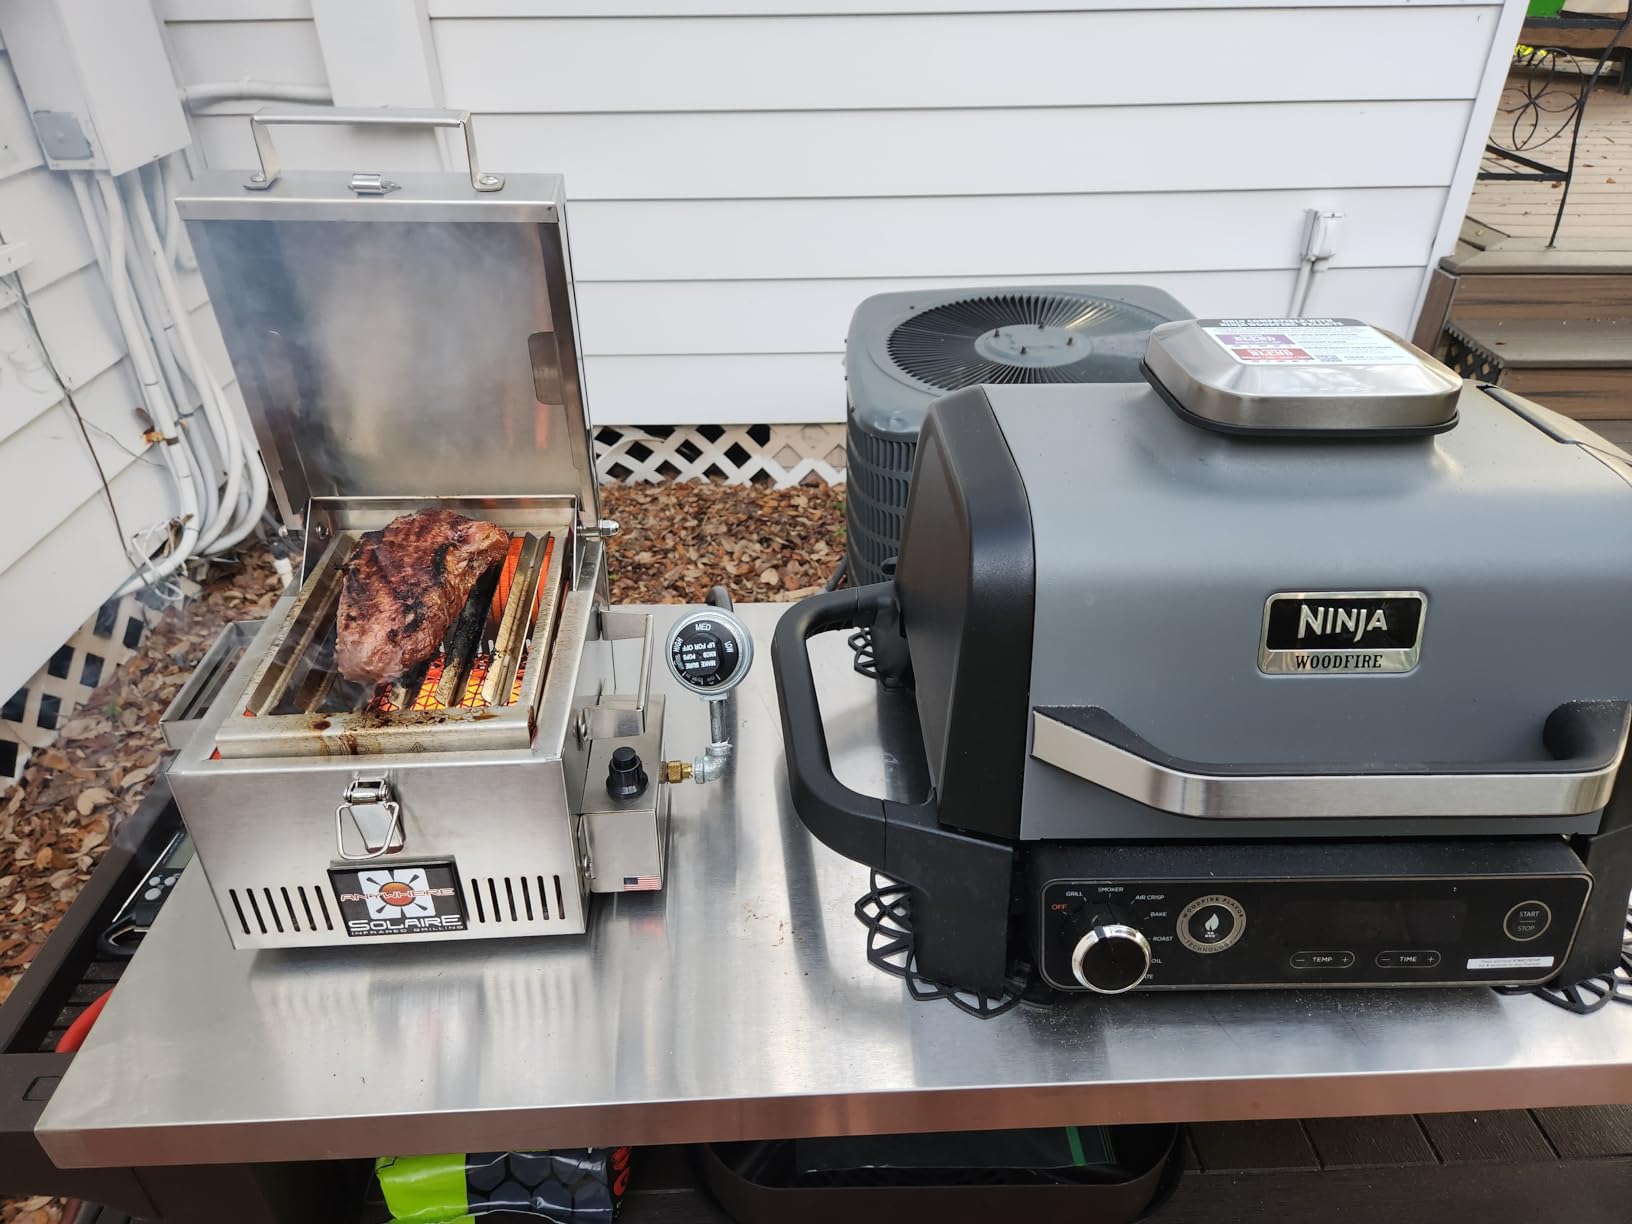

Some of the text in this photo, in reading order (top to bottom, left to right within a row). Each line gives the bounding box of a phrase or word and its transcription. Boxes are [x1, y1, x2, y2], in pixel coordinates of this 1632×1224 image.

[695, 623, 711, 631] MED
[1297, 604, 1388, 643] NINJA
[1296, 654, 1383, 669] WOODFIRE
[340, 887, 456, 902] ANYWHERE
[1051, 903, 1068, 911] OFF
[1519, 910, 1540, 918] START
[348, 915, 462, 931] SOLAIRE
